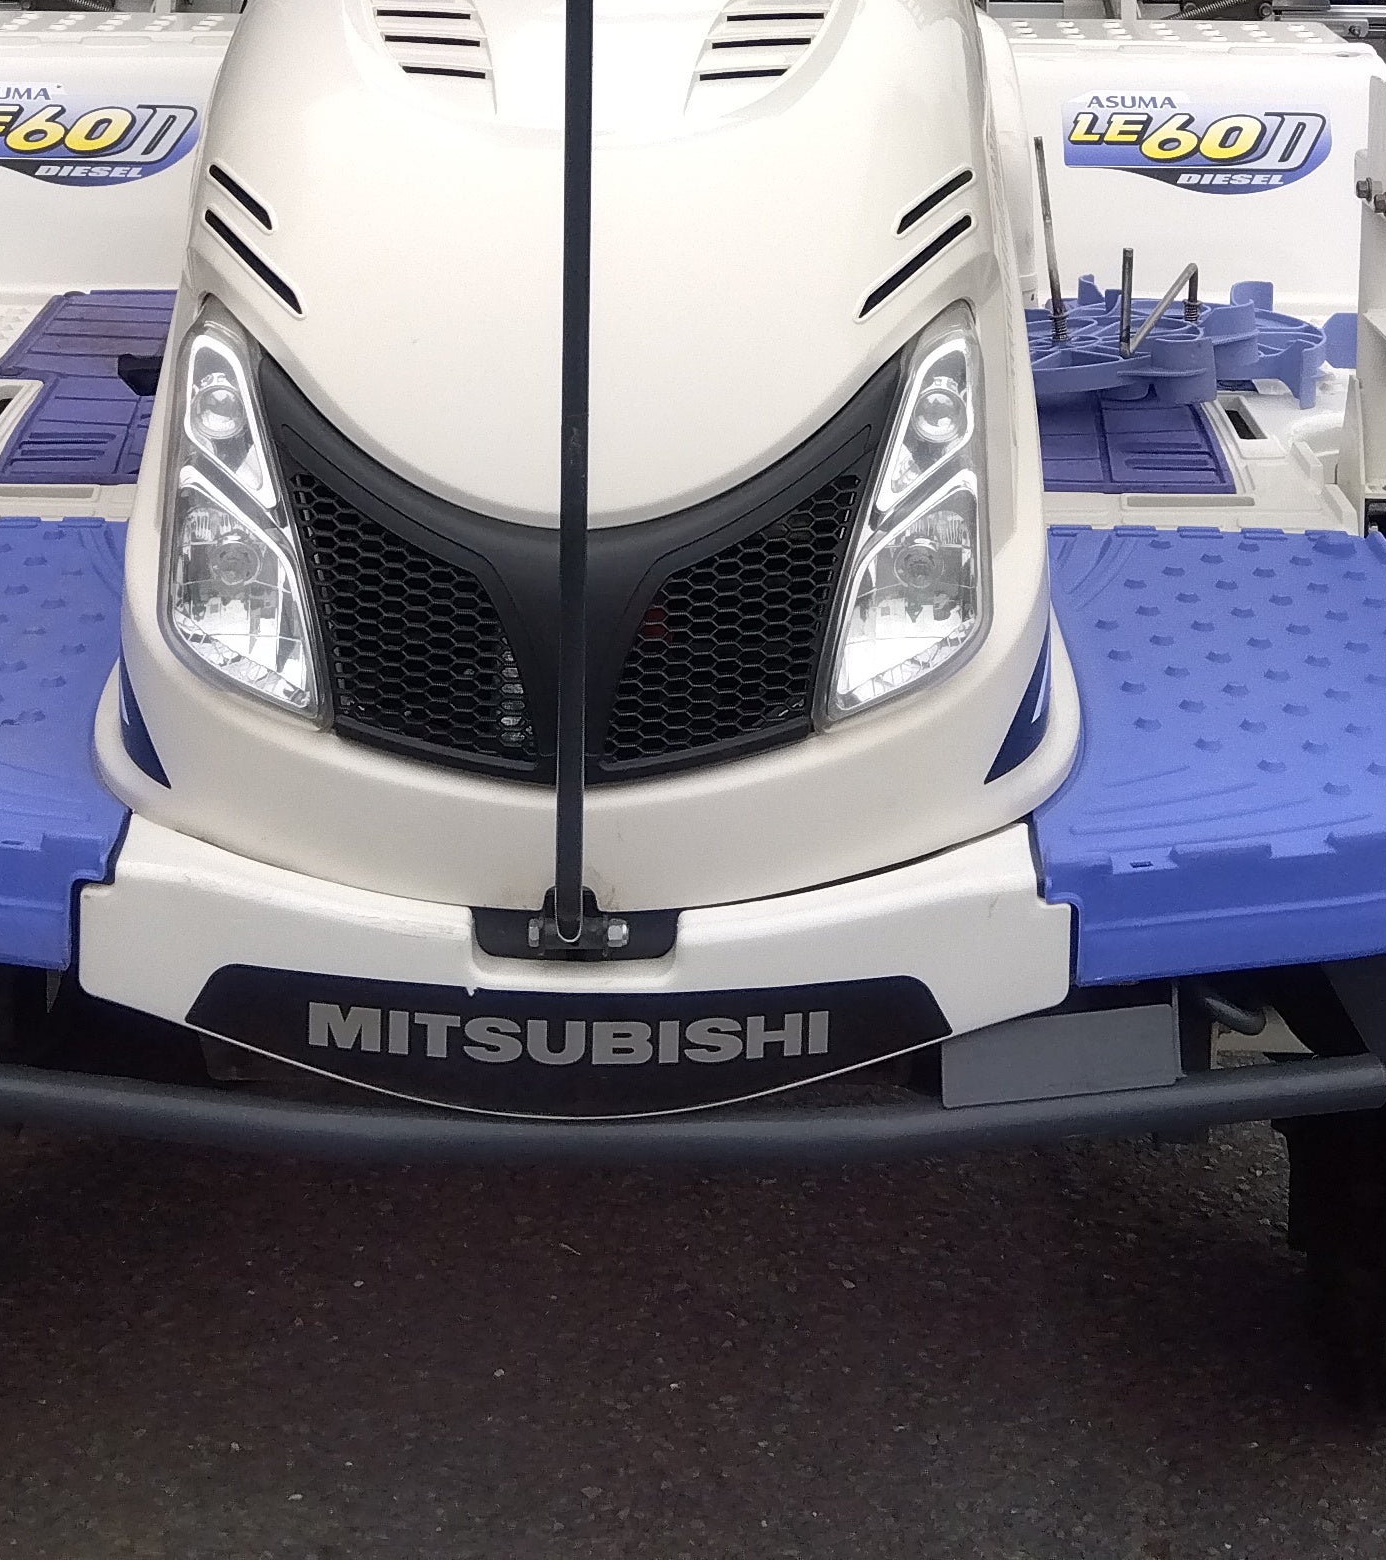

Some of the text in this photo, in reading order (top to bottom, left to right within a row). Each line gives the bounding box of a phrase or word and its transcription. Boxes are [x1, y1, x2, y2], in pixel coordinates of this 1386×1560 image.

[1087, 95, 1177, 109] ASUMA
[34, 165, 144, 178] DIESEL
[1176, 173, 1284, 186] DIESEL
[308, 1001, 830, 1065] MITSUBISHI
